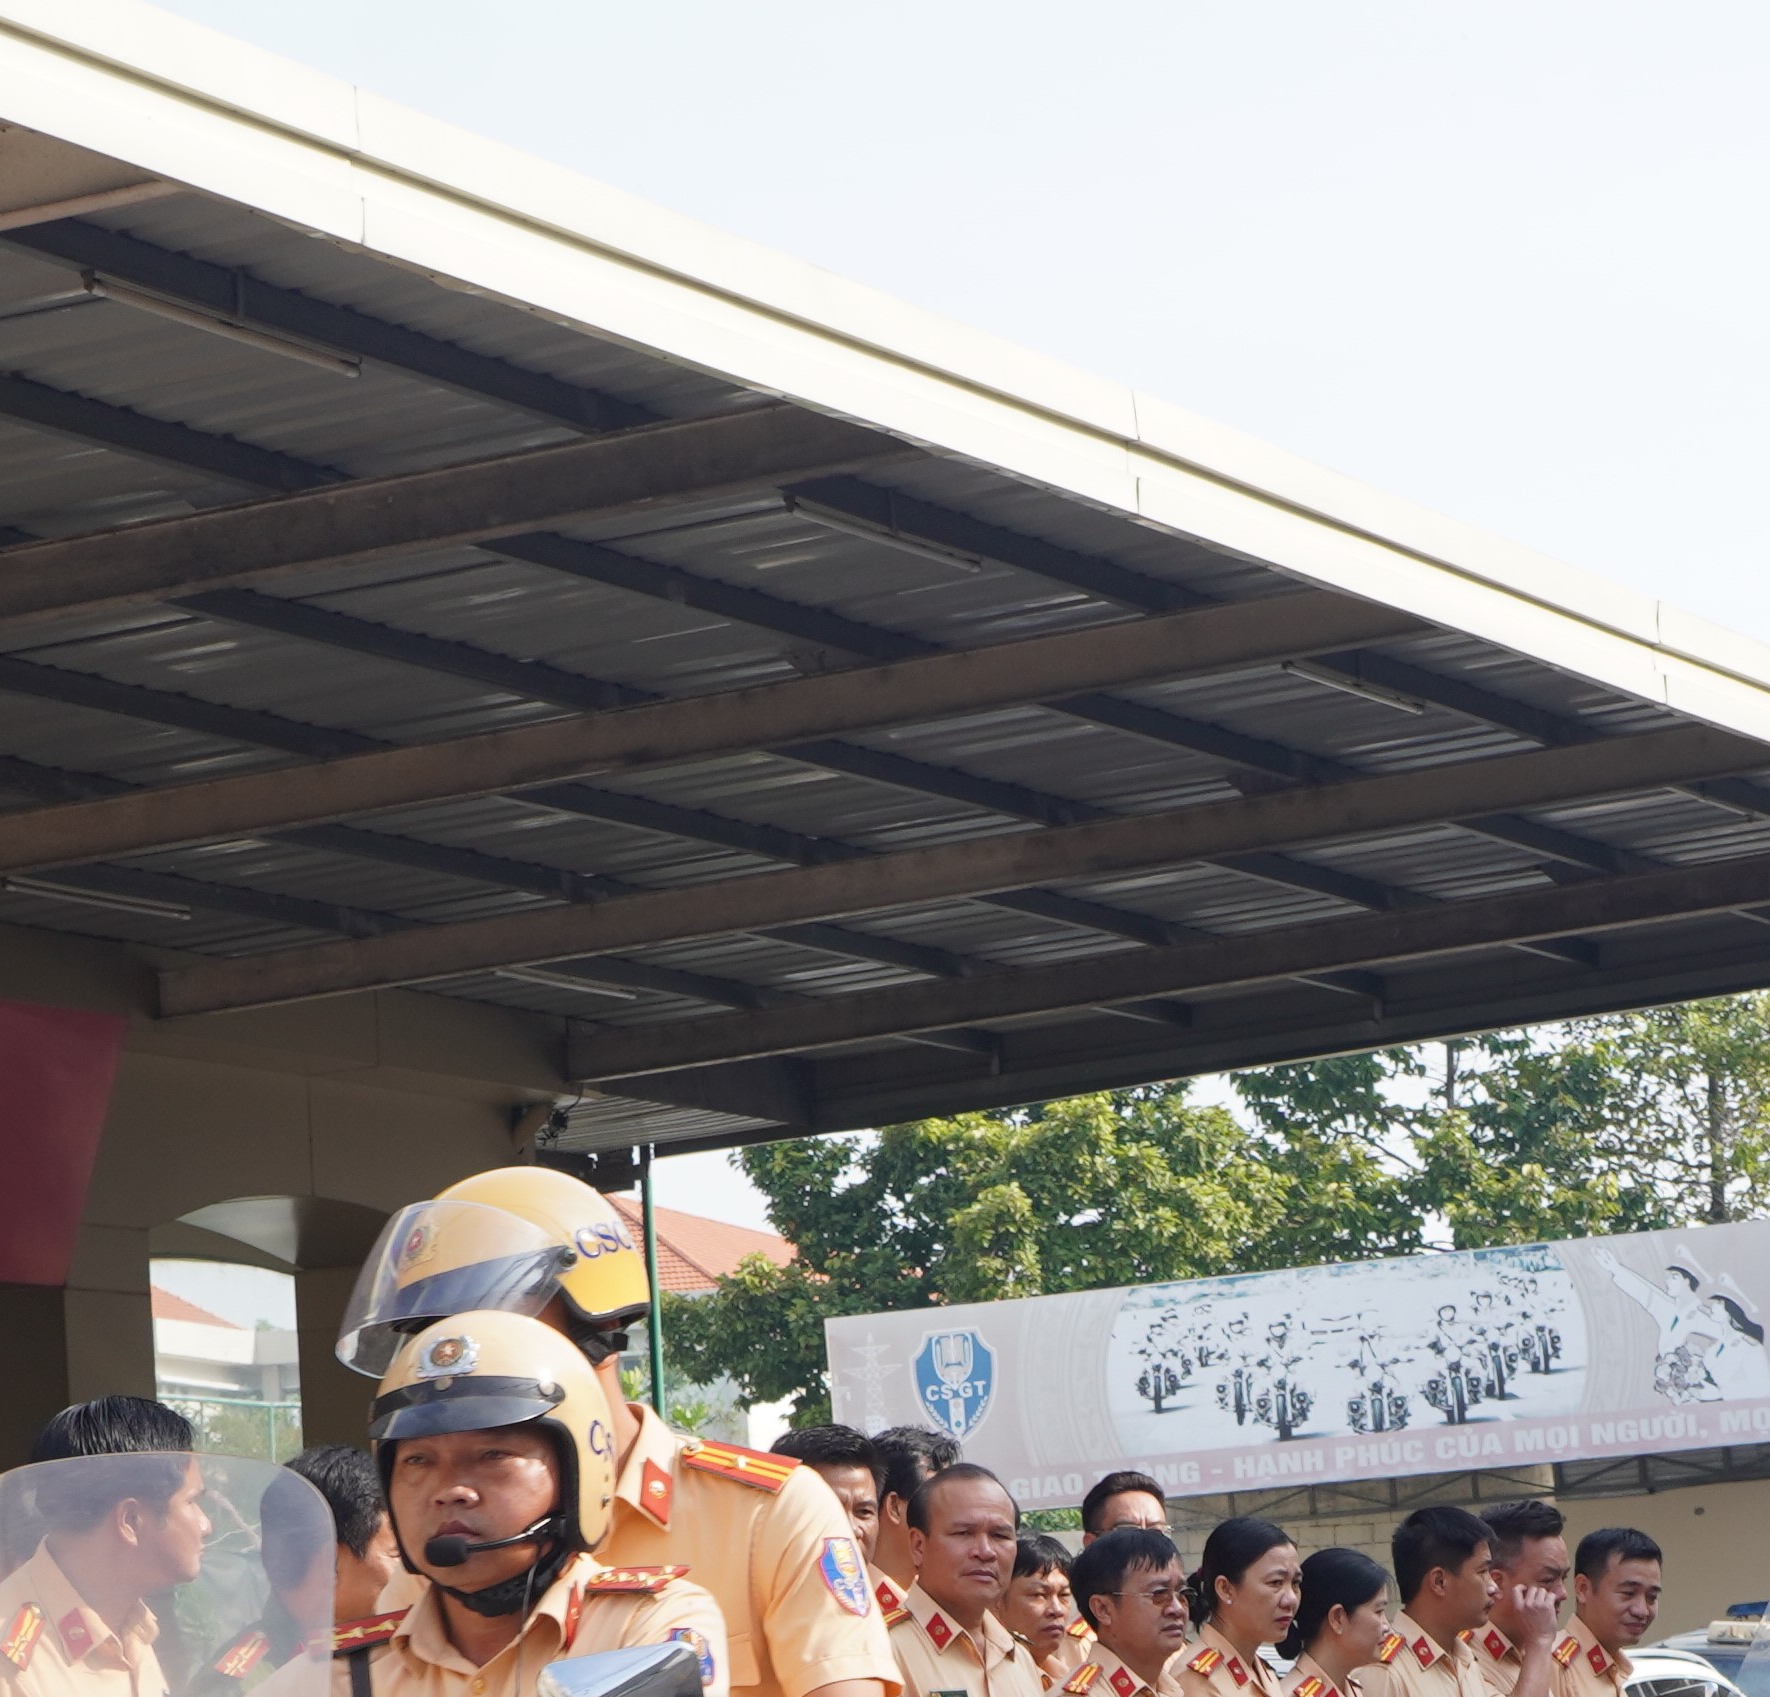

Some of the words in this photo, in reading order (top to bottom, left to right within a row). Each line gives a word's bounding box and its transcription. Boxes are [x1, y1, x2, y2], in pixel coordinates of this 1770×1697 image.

[926, 1380, 986, 1401] CSGT
[1010, 1472, 1084, 1498] GIAO
[1233, 1449, 1325, 1481] HẠNH
[1336, 1436, 1426, 1470] PHÚC
[1435, 1428, 1504, 1460] CỦA
[1514, 1425, 1580, 1458] MỌI
